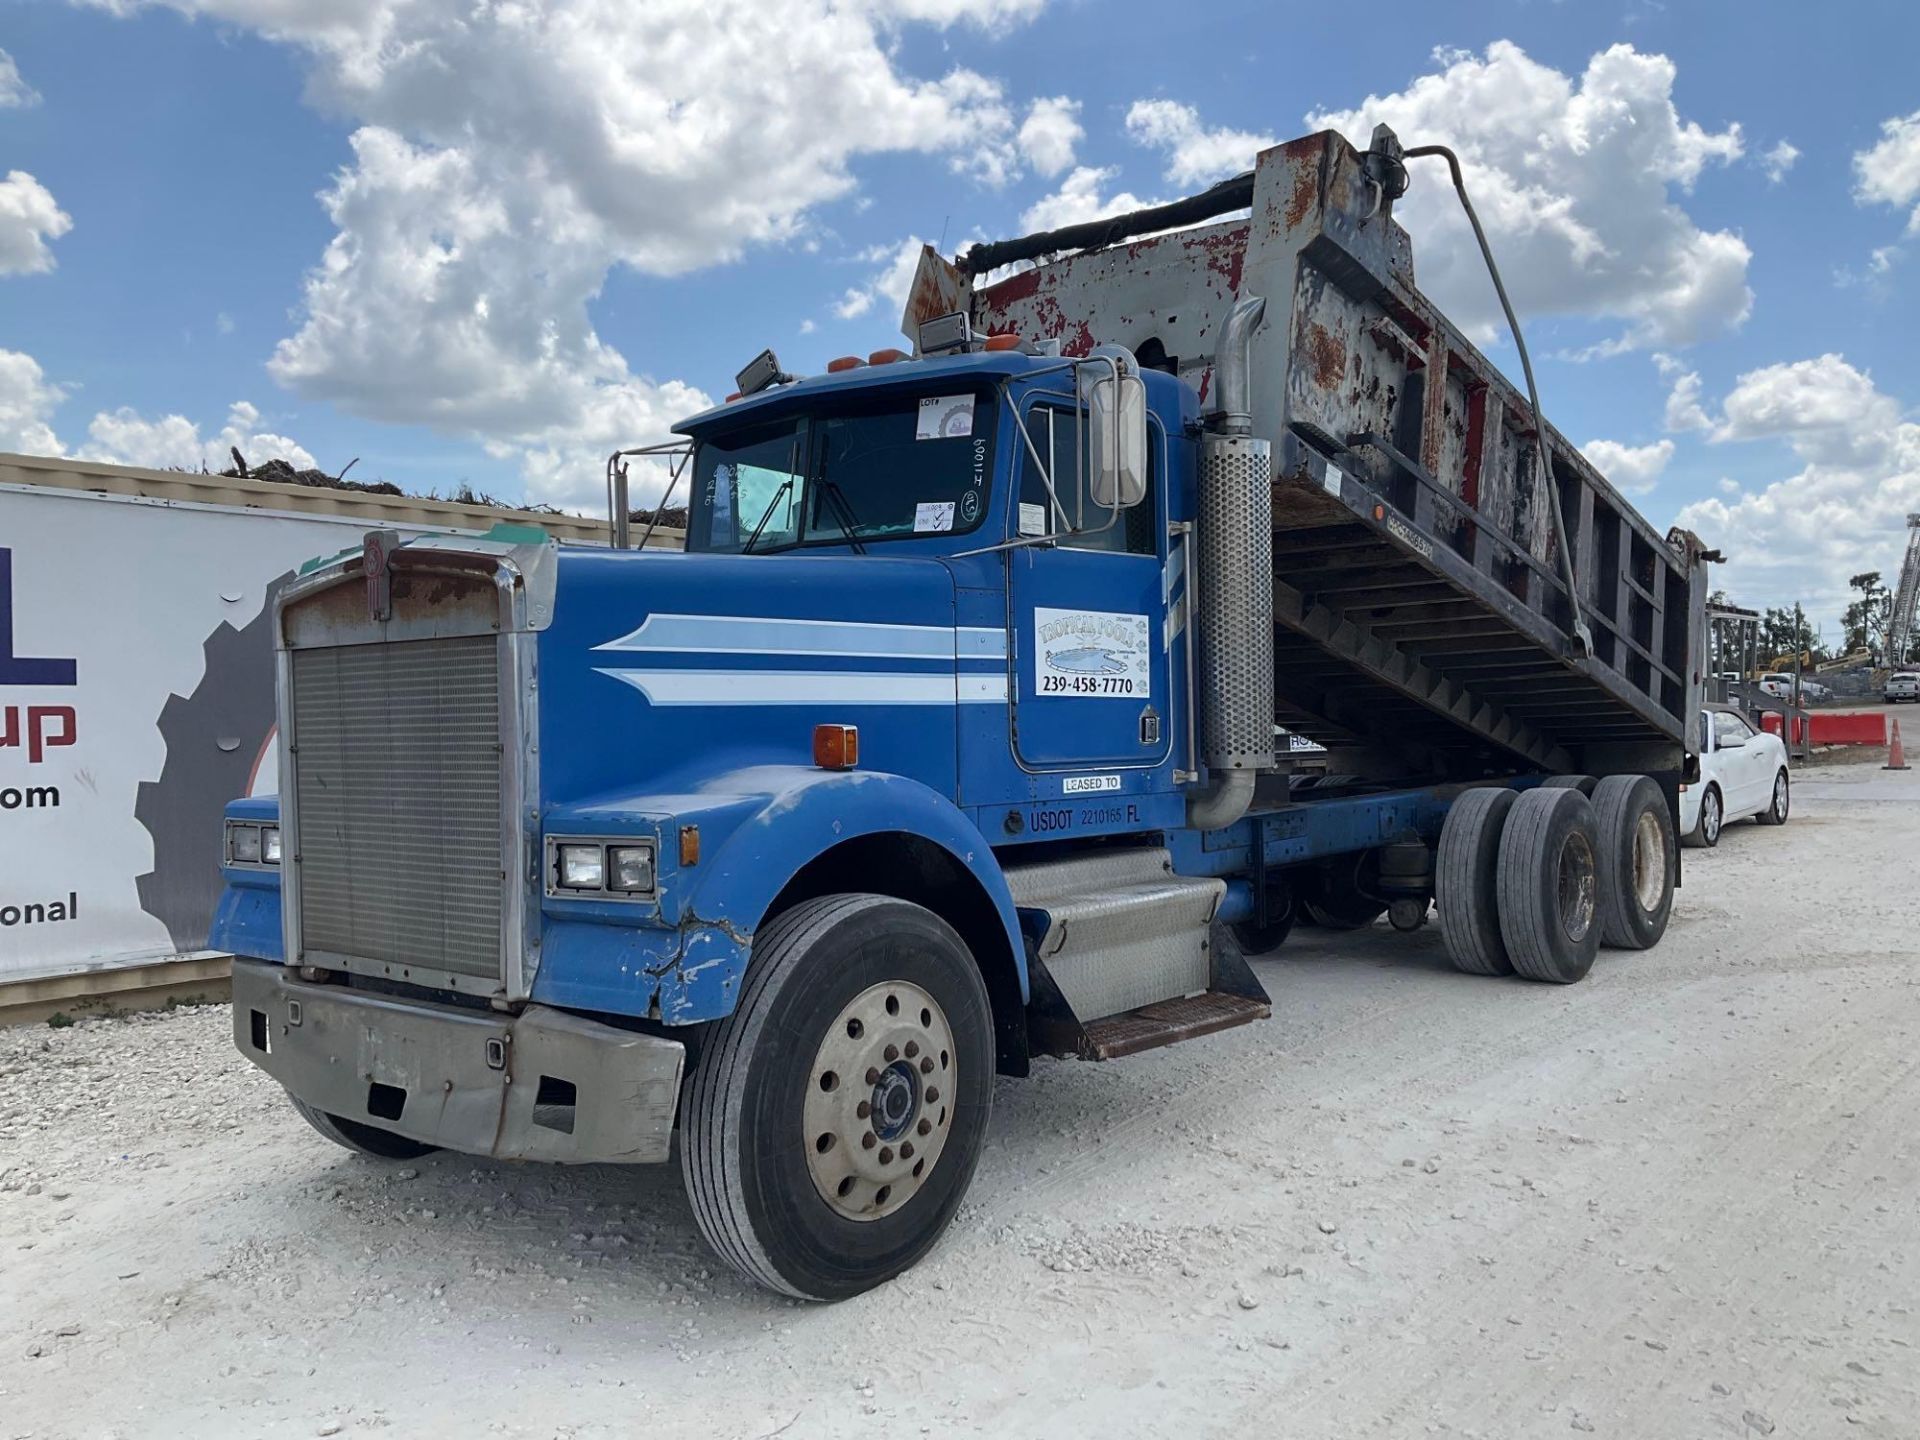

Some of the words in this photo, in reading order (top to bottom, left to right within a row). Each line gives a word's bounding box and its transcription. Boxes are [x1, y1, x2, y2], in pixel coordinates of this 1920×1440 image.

[1038, 615, 1096, 644] TROPICAL
[1099, 616, 1135, 648] POOLS
[1066, 779, 1102, 791] LEASED
[1106, 777, 1118, 788] TO
[1031, 810, 1073, 832] USDOT
[1081, 808, 1122, 825] 2210165
[1127, 805, 1140, 823] FL
